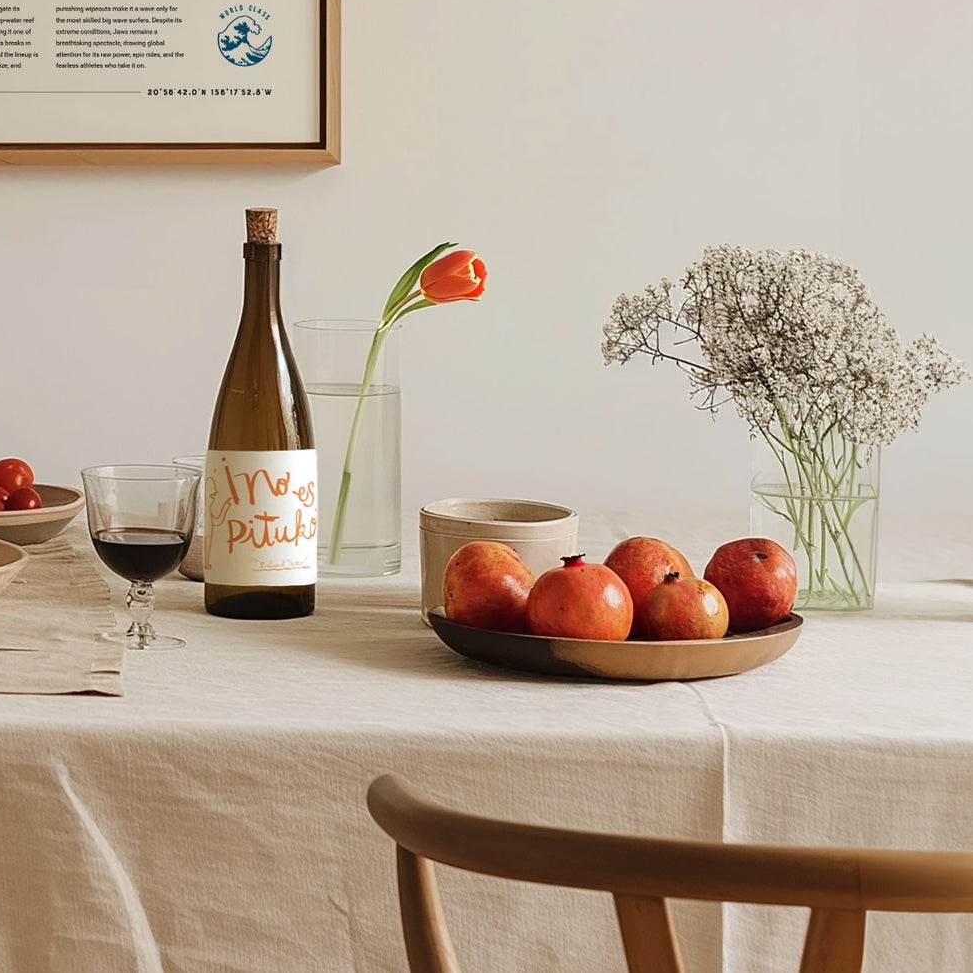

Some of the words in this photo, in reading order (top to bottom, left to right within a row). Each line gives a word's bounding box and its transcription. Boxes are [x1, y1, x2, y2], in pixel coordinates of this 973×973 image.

[55, 5, 84, 14] punishing
[155, 5, 169, 14] only
[219, 4, 244, 19] WORLD
[248, 4, 271, 20] CLASS
[101, 17, 112, 25] big
[128, 16, 151, 24] surfers.
[151, 16, 174, 25] Despite
[80, 28, 113, 36] conditions,
[129, 28, 153, 36] remains
[55, 39, 92, 48] breathtaking
[93, 39, 123, 48] spectacle,
[122, 39, 147, 48] drawing
[147, 39, 165, 48] global
[14, 51, 33, 59] lineup
[132, 51, 145, 59] epic
[145, 51, 162, 59] rides,
[292, 481, 315, 508] es
